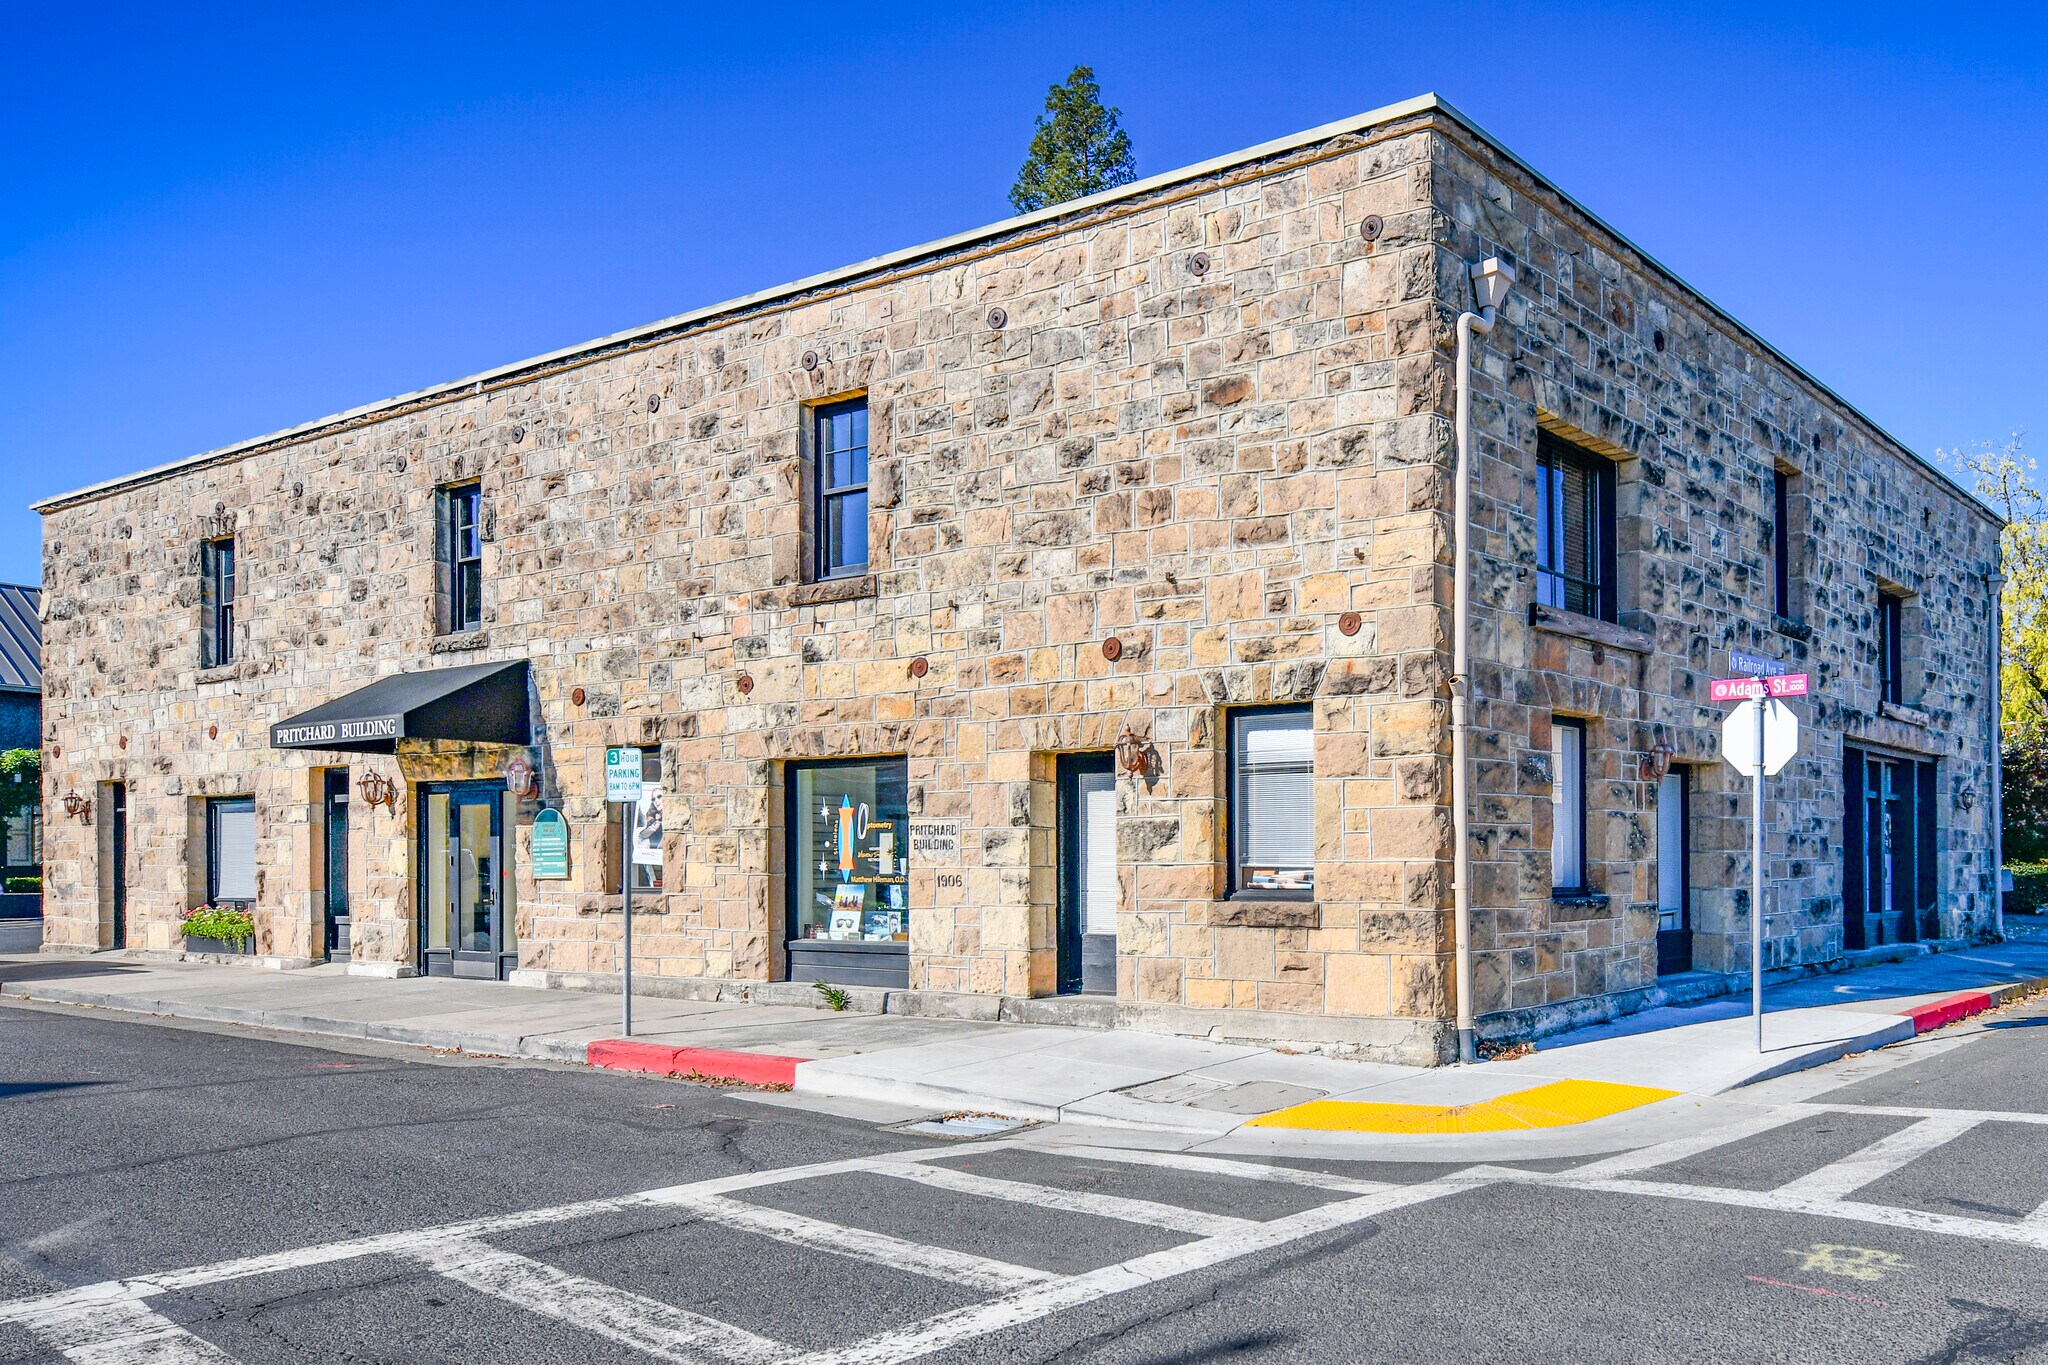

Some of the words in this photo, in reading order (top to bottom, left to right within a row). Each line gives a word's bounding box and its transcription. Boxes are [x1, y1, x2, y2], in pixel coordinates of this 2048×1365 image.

[1738, 656, 1765, 675] Railroad
[1766, 662, 1777, 677] Ave
[1728, 681, 1769, 697] Adams
[1773, 678, 1790, 694] St.
[1789, 683, 1805, 691] 1000
[276, 724, 336, 744] PRITCHARD
[341, 719, 396, 738] BUILDING
[609, 751, 618, 764] 3
[620, 754, 639, 763] HOUR
[609, 768, 640, 779] PARKING
[609, 782, 620, 791] 8AM
[621, 782, 628, 791] TO
[629, 781, 640, 791] 6PM
[909, 824, 957, 836] PRITCHARD
[913, 839, 954, 850] BUILDING
[850, 875, 873, 883] Matthew
[937, 874, 963, 888] 1906
